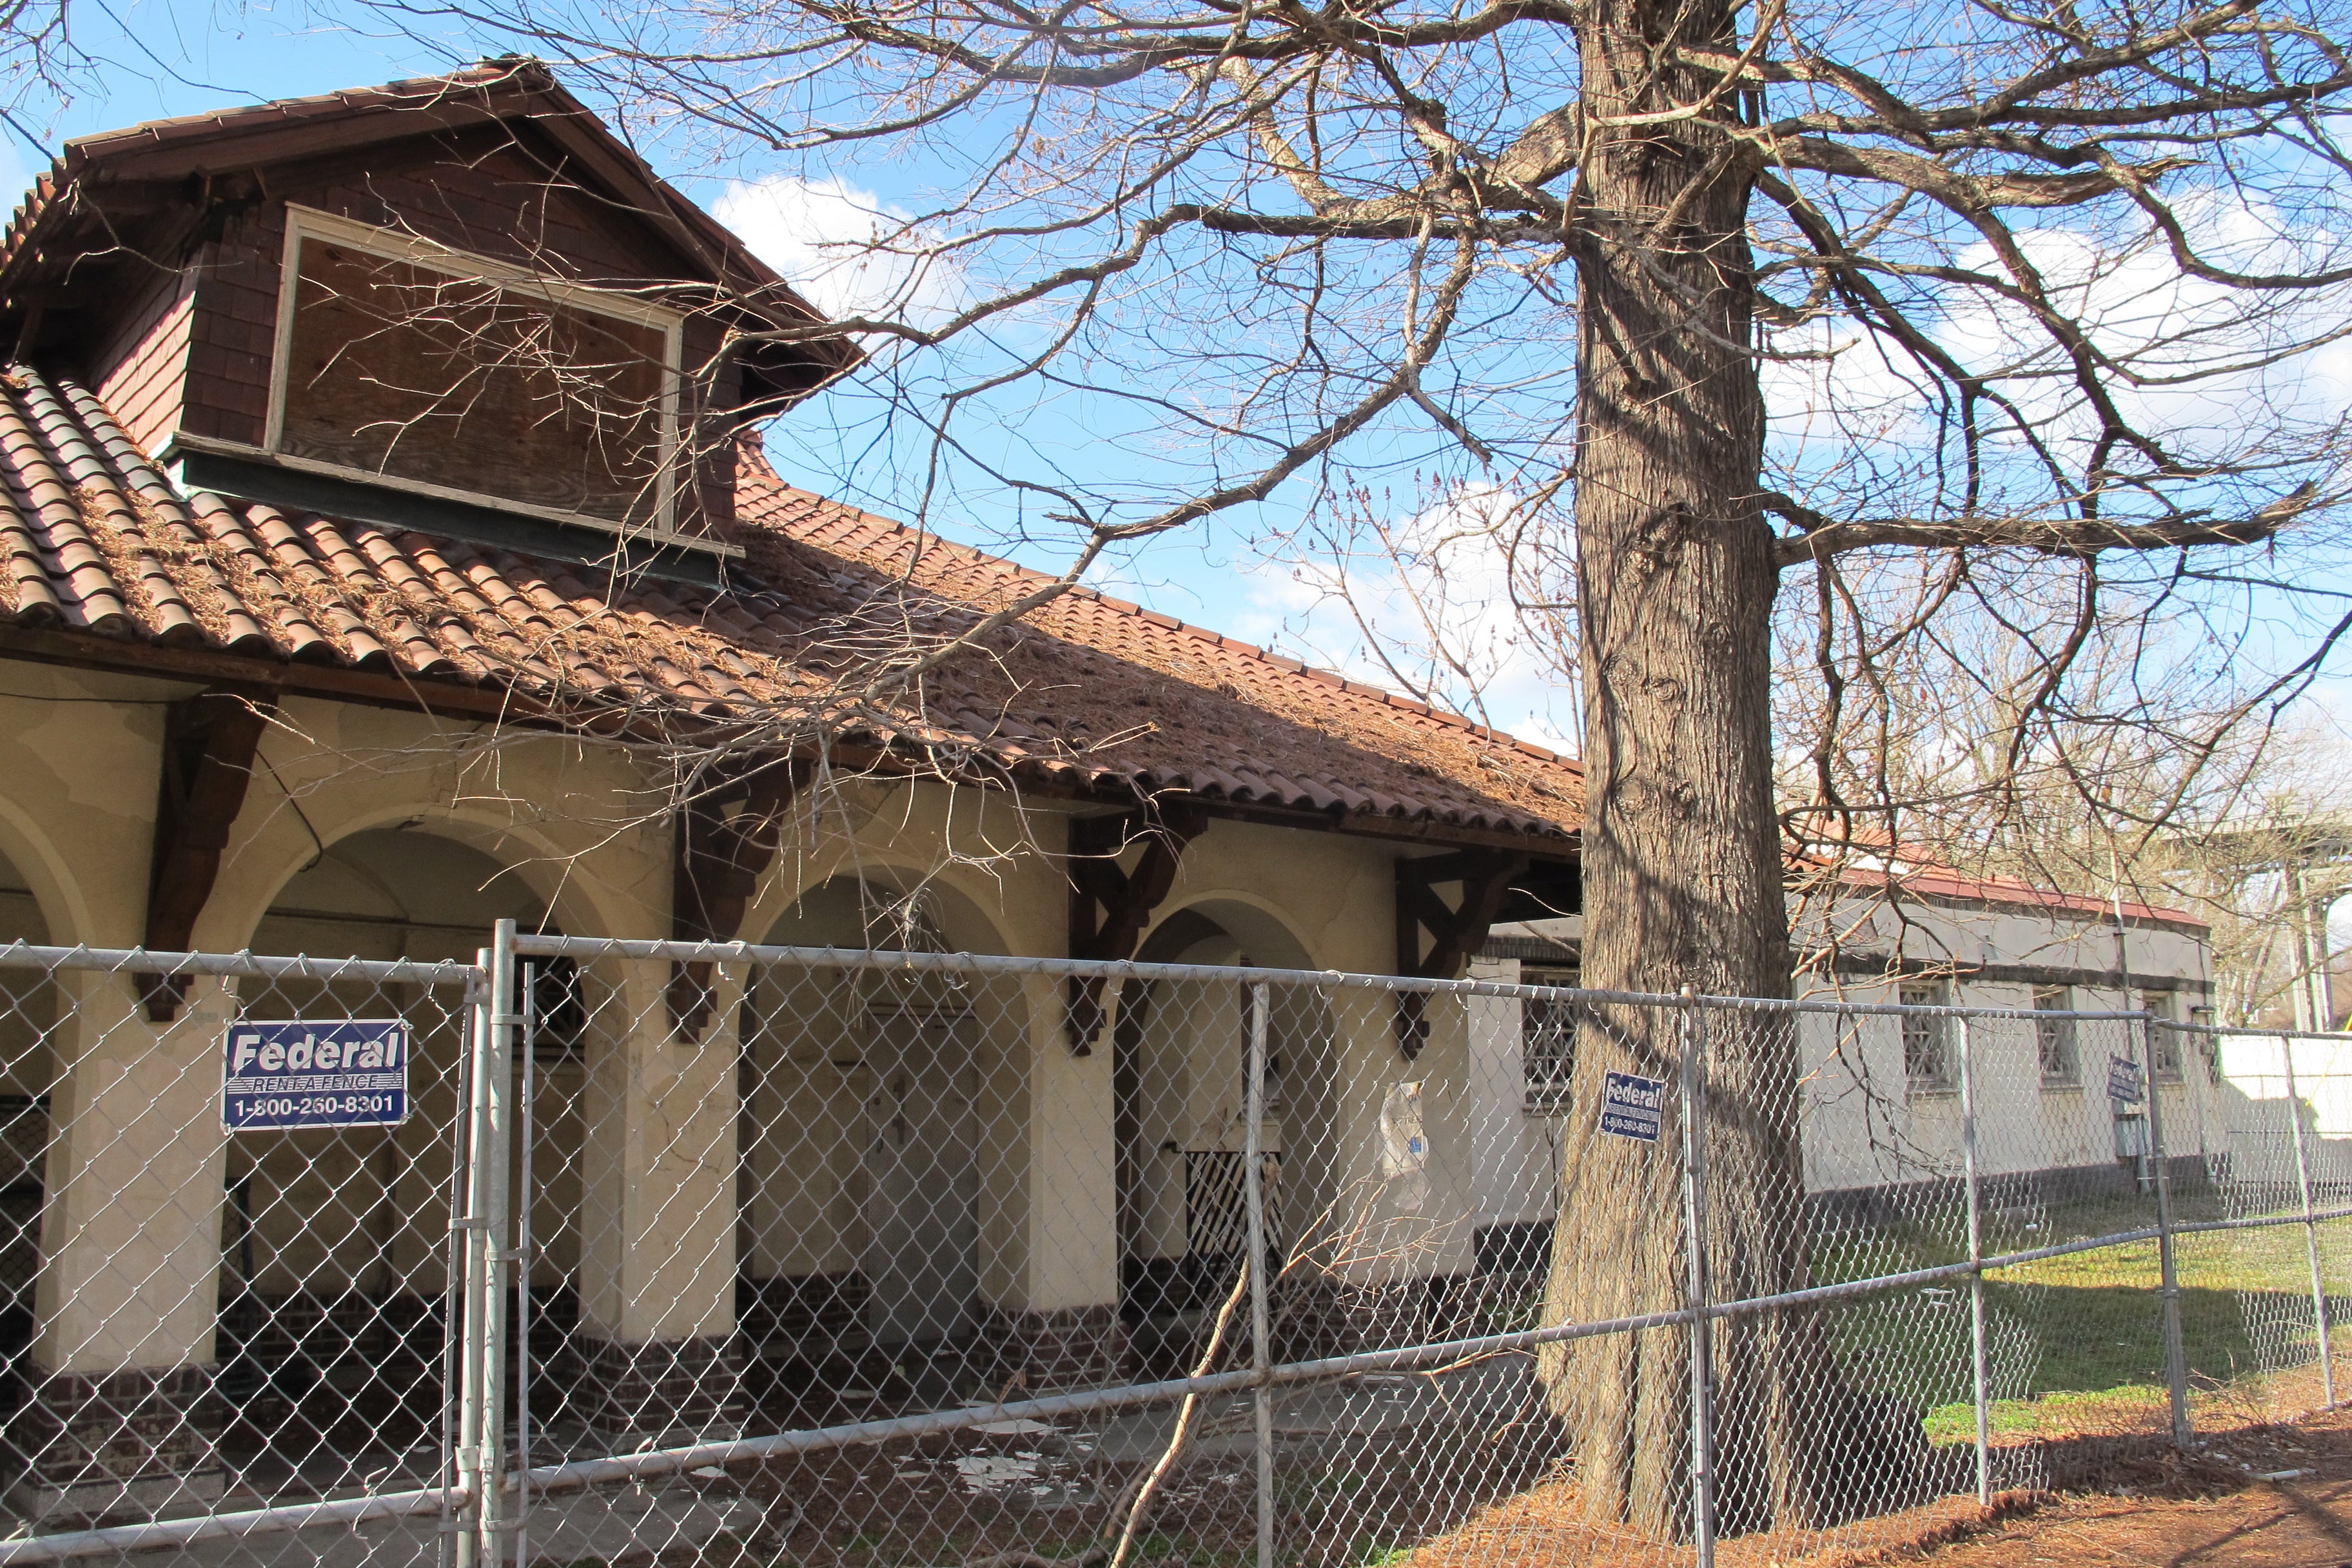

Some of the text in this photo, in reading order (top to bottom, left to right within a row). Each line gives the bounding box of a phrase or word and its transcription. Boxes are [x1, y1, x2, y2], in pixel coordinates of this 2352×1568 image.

[234, 1032, 398, 1073] Federal
[253, 1074, 379, 1092] RENT A FENCE
[1606, 1077, 1660, 1108] Federal
[235, 1095, 393, 1117] 1-800-260-8301
